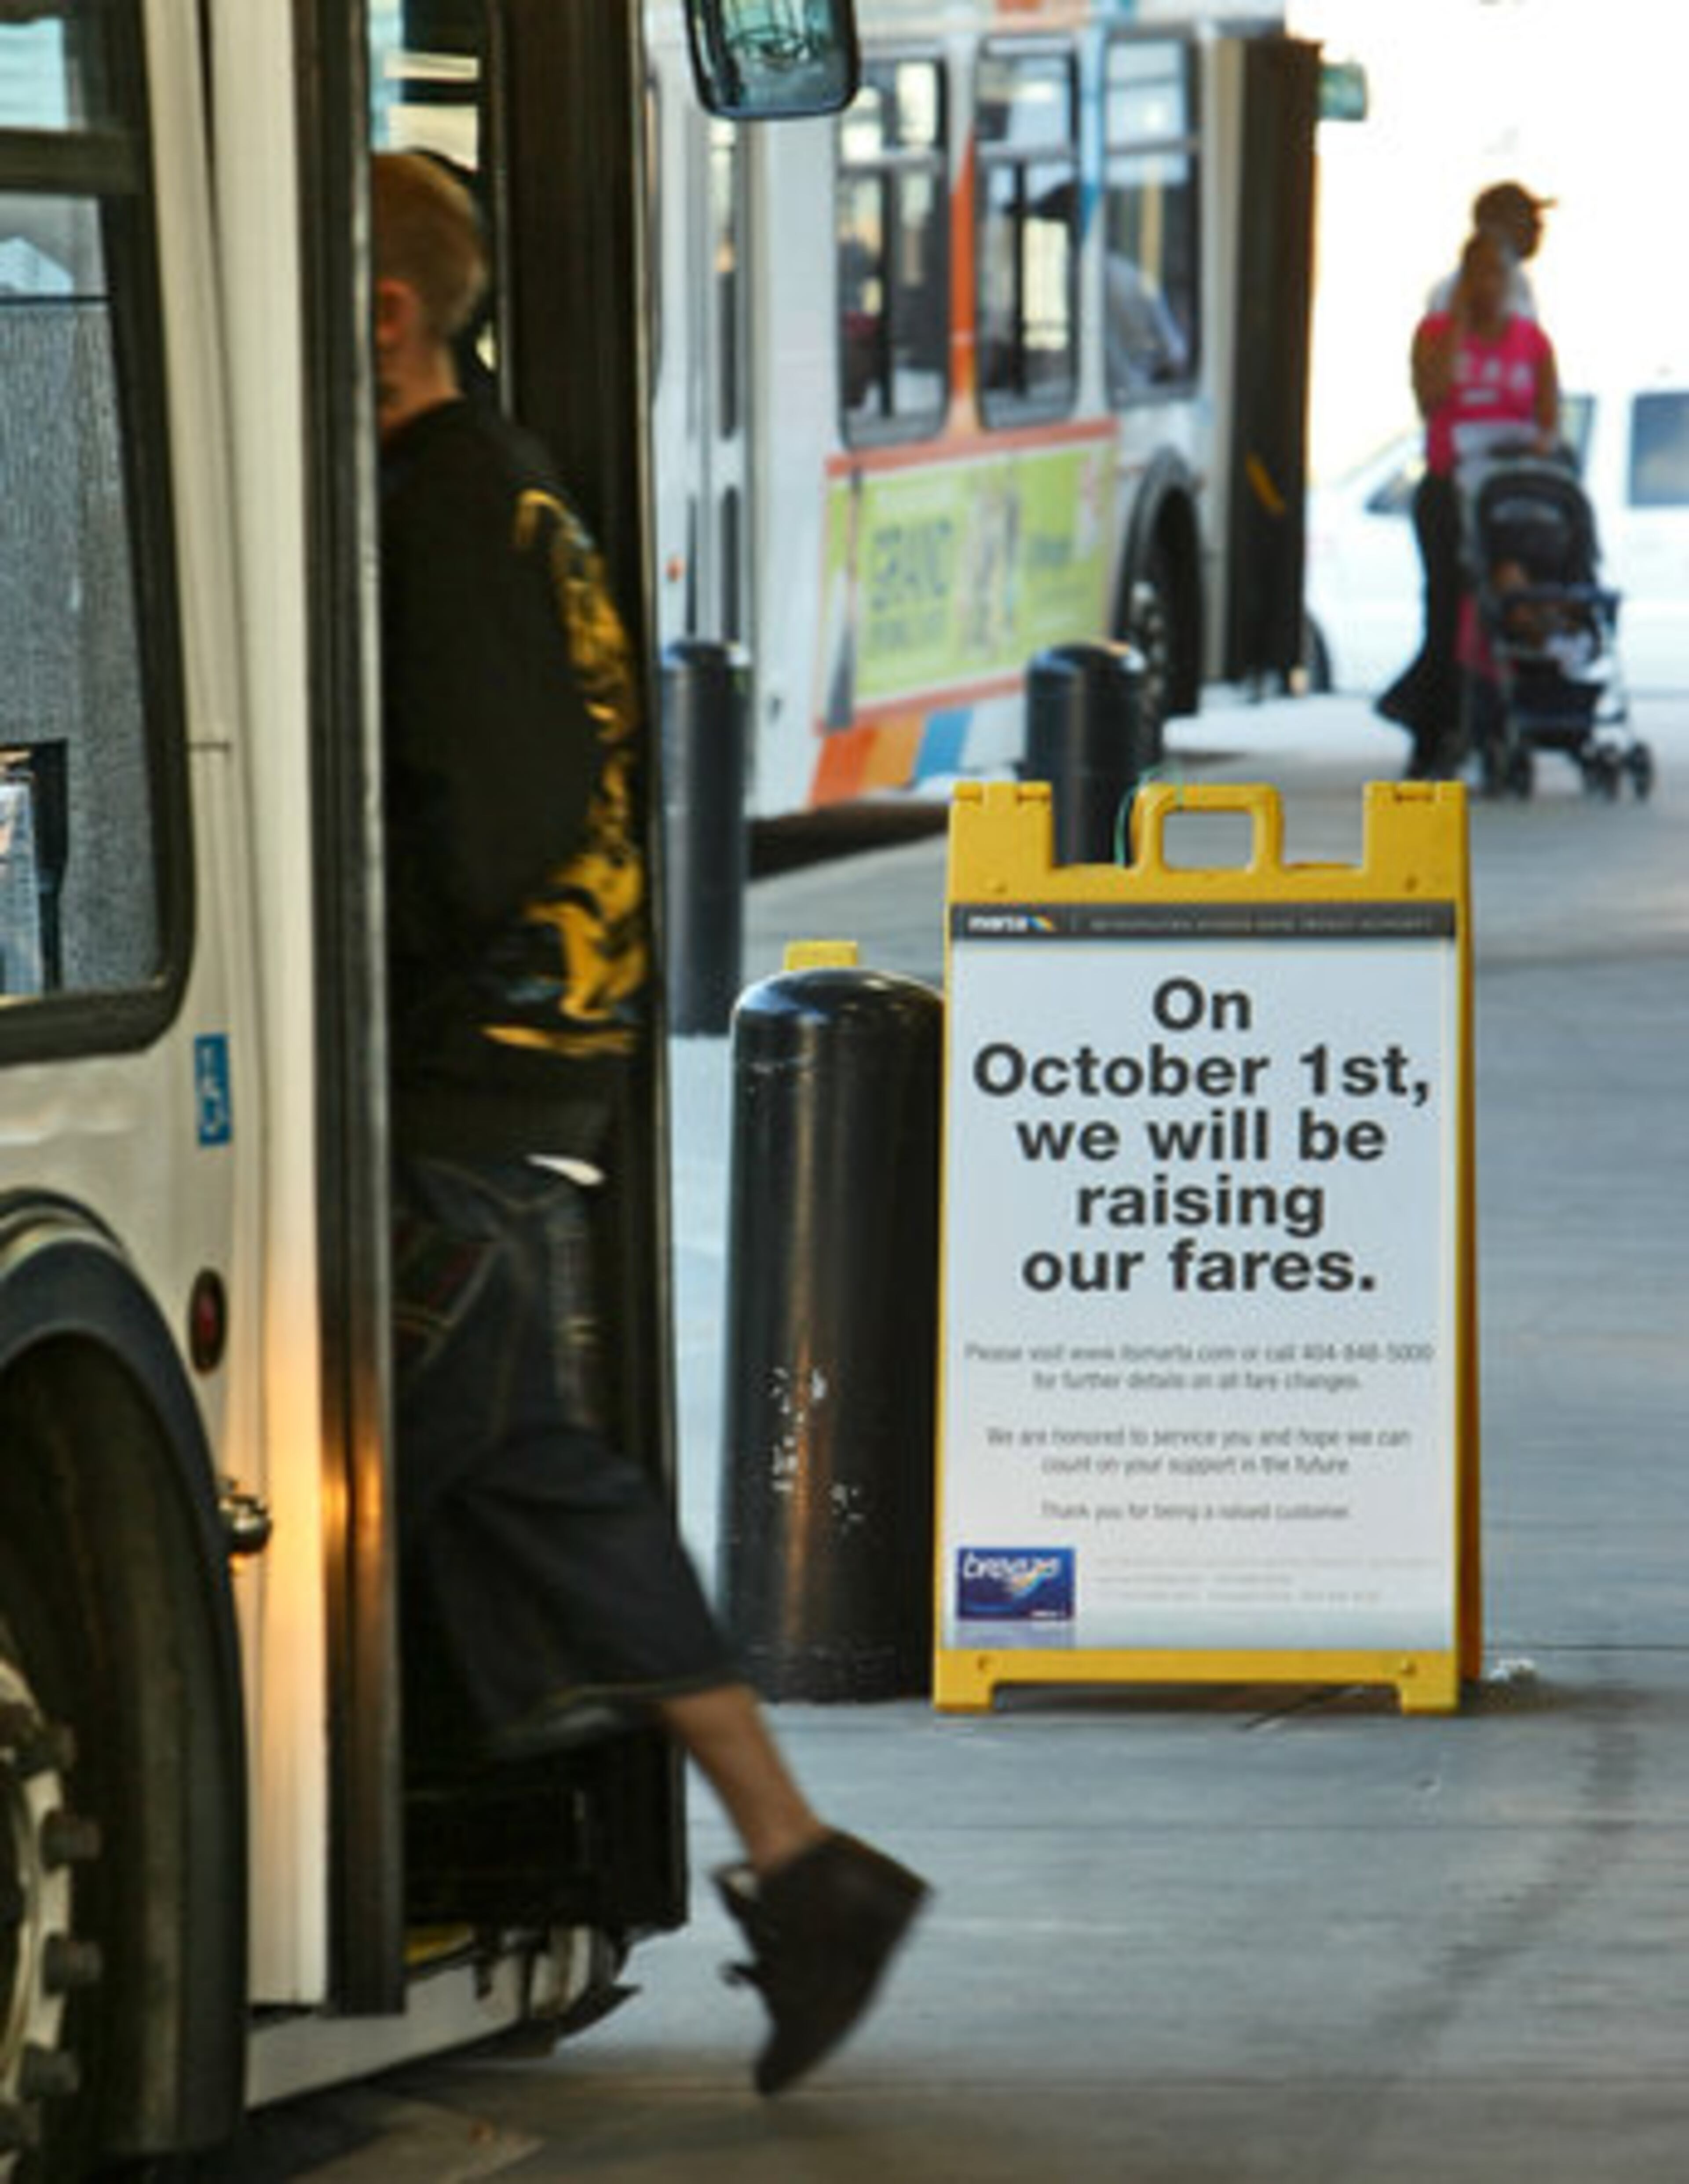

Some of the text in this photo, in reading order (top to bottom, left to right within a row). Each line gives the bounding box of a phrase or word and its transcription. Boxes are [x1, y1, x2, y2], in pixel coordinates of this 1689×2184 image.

[1152, 977, 1251, 1032] On
[972, 1042, 1429, 1107] October 1st,
[1015, 1108, 1386, 1162] we will be
[1077, 1172, 1324, 1240] raising
[1021, 1237, 1375, 1292] our fares.
[965, 1344, 1021, 1362] Please
[1030, 1344, 1064, 1362] visit
[1241, 1349, 1257, 1362] or
[1265, 1344, 1294, 1362] call
[1033, 1371, 1056, 1389] for
[1061, 1371, 1120, 1389] further
[1127, 1371, 1184, 1389] details
[1192, 1374, 1212, 1389] on
[1219, 1371, 1236, 1389] all
[1245, 1371, 1276, 1389] fare
[987, 1428, 1409, 1450] We are honored to service you and hope we can
[1042, 1457, 1090, 1473] count
[1096, 1460, 1119, 1473] on
[1125, 1461, 1162, 1477] your
[1168, 1457, 1236, 1477] support
[1241, 1456, 1256, 1473] in
[1261, 1456, 1290, 1473] the
[1041, 1499, 1089, 1518] Thank
[1095, 1504, 1123, 1522] you
[1129, 1499, 1148, 1518] for
[1154, 1499, 1198, 1522] being
[1221, 1499, 1271, 1518] valued
